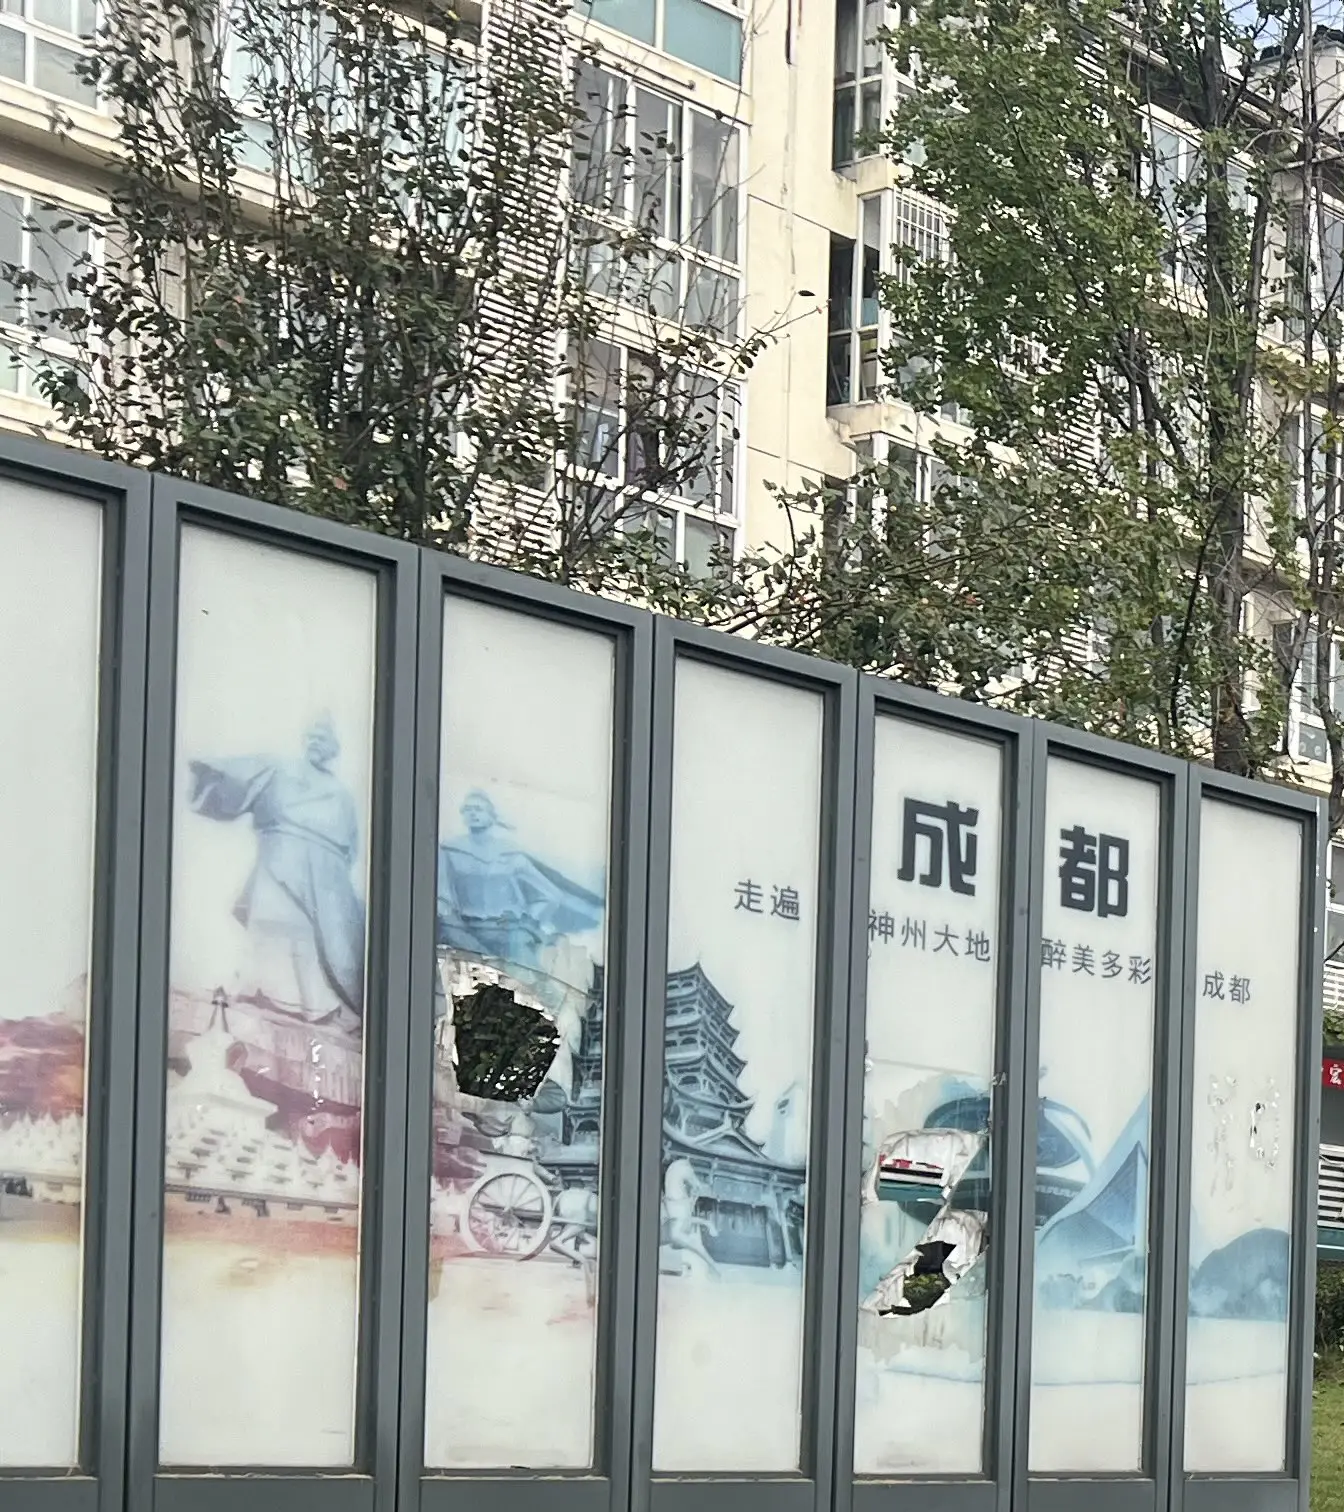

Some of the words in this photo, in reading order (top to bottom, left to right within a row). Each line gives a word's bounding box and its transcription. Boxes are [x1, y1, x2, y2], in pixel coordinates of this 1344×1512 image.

[734, 878, 799, 921] 走遍
[869, 909, 990, 962] 神州大地
[1041, 937, 1151, 985] 醉美多彩
[1203, 970, 1250, 1004] 成都
